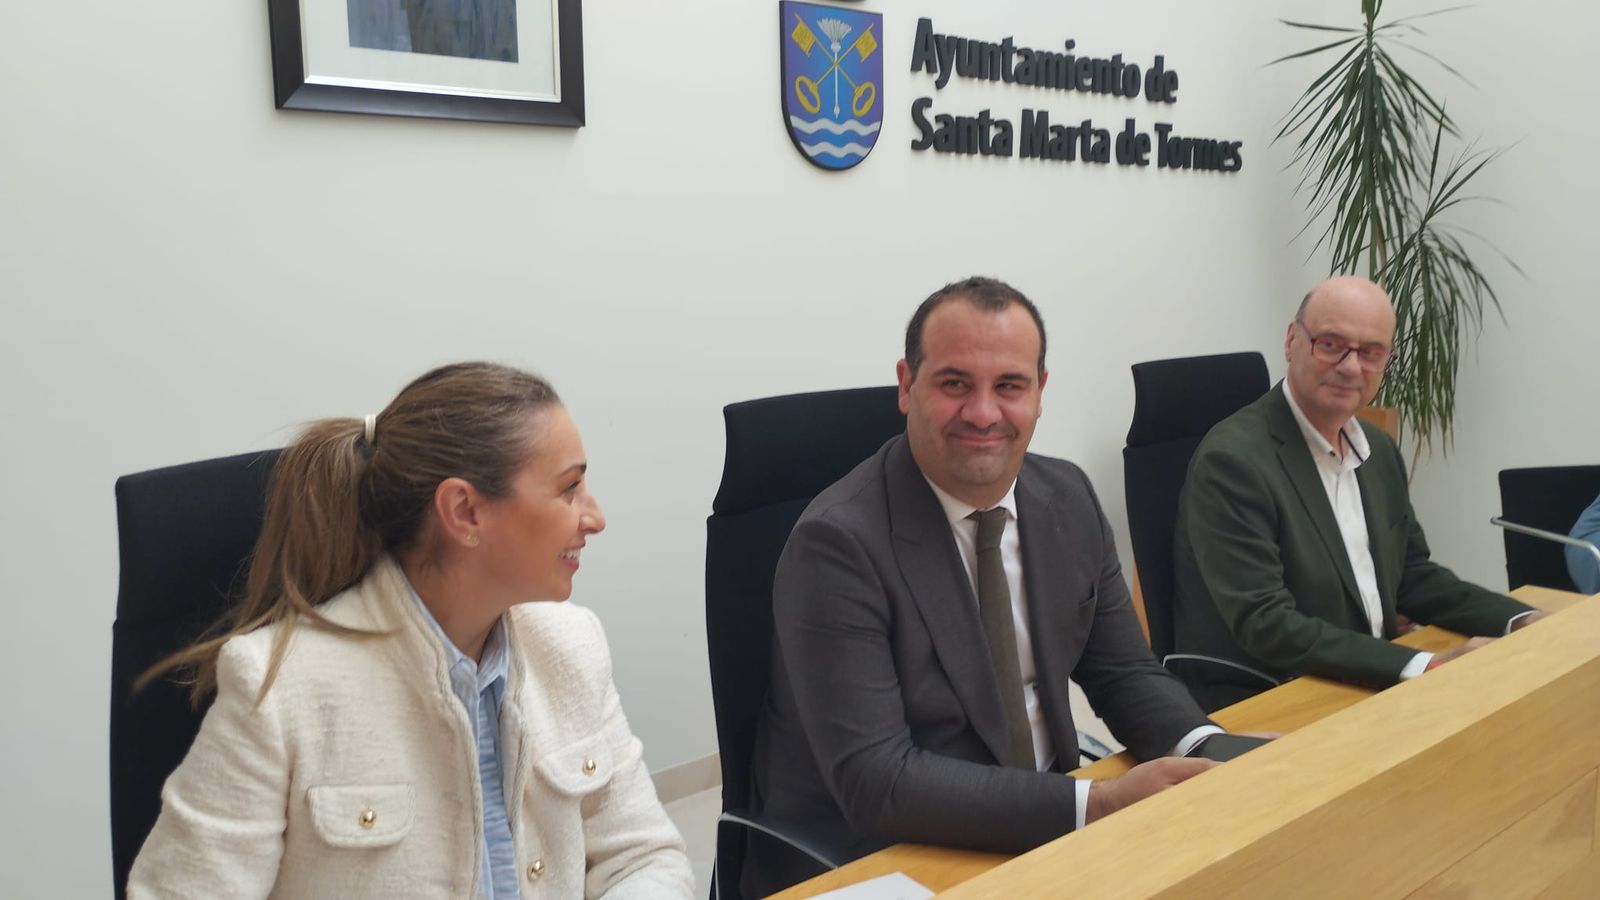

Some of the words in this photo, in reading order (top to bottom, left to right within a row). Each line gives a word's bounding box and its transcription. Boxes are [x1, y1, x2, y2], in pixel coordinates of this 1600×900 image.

[910, 17, 1142, 99] Ayuntamiento
[1144, 55, 1179, 104] de
[910, 97, 1014, 158] Santa
[1019, 108, 1111, 165] Marta
[1115, 118, 1152, 167] de
[1154, 123, 1243, 173] Tormes
